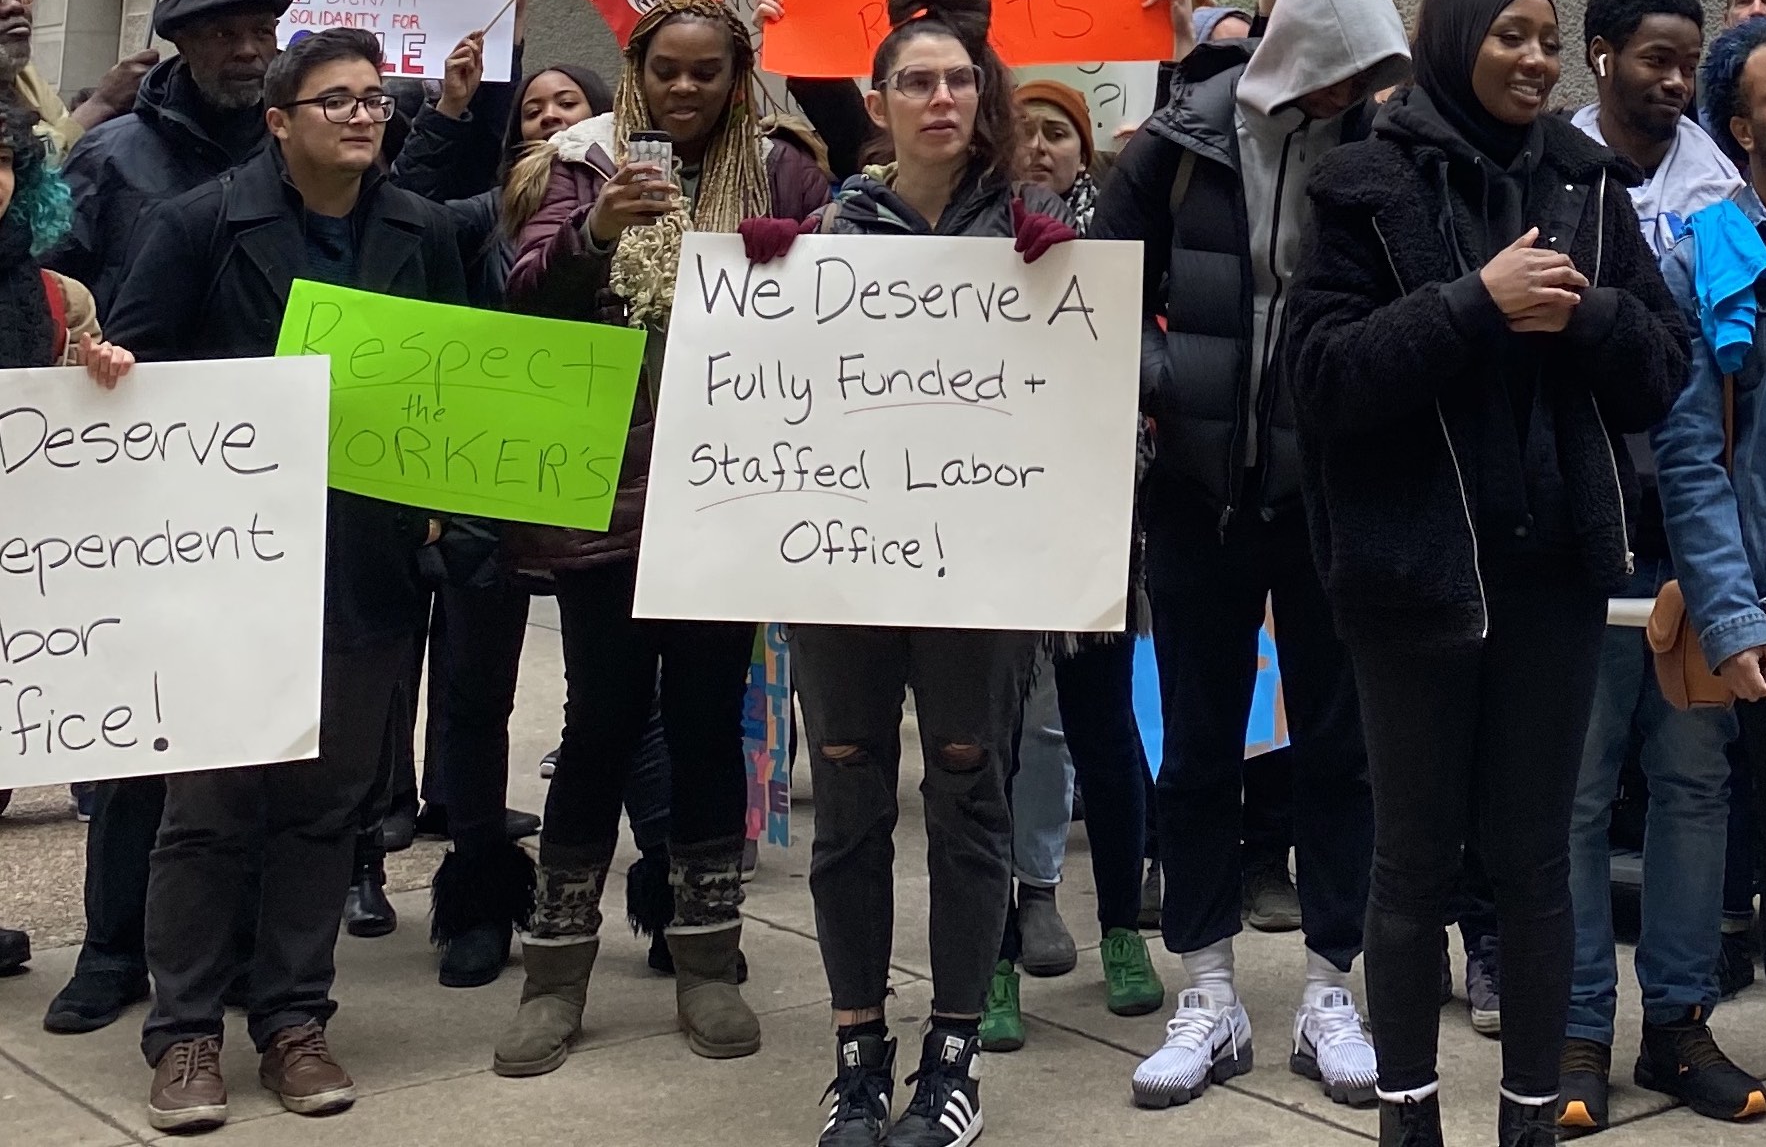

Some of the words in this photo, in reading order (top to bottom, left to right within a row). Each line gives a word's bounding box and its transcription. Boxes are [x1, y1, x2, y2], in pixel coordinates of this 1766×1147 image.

[290, 9, 379, 29] SOLIDARITY
[392, 14, 421, 29] FOR
[696, 253, 795, 319] We
[815, 257, 1031, 325] Deserve
[1047, 274, 1099, 341] A
[300, 301, 622, 406] Respect
[401, 394, 446, 424] the
[707, 351, 814, 425] Fully
[837, 353, 1007, 404] Funded
[0, 407, 279, 474] Deserve
[688, 441, 871, 492] Staffed
[905, 447, 1045, 491] Labor
[780, 520, 948, 579] Office!
